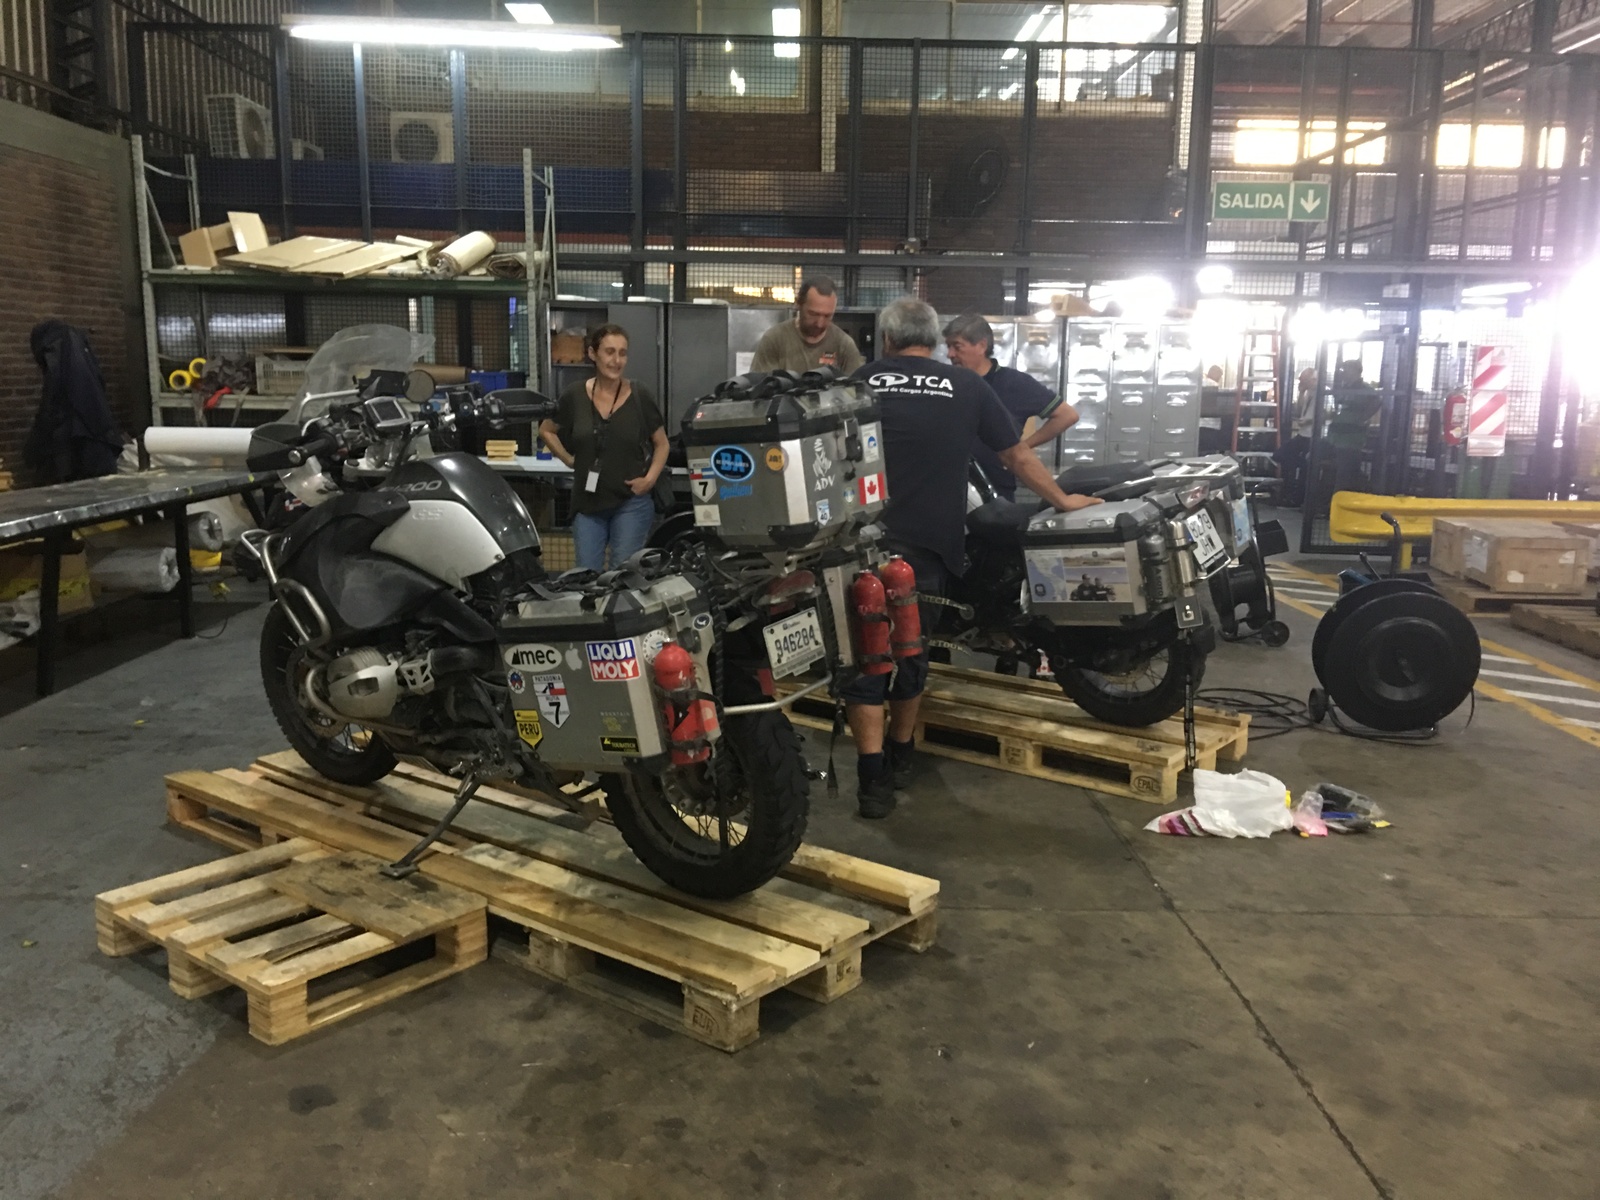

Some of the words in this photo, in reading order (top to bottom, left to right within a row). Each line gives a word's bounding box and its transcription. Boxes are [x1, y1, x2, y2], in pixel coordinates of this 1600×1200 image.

[1219, 192, 1285, 209] SALIDA
[912, 375, 953, 391] TCA
[922, 388, 954, 398] Argentina
[720, 452, 745, 472] BA
[698, 481, 709, 496] 7
[815, 474, 836, 491] ADV
[774, 624, 816, 658] 946284
[519, 649, 557, 665] mec
[588, 641, 633, 660] LIQUI
[592, 660, 636, 679] MOLY
[548, 702, 561, 725] 7
[519, 723, 540, 736] PERU
[1138, 777, 1159, 793] EPAL
